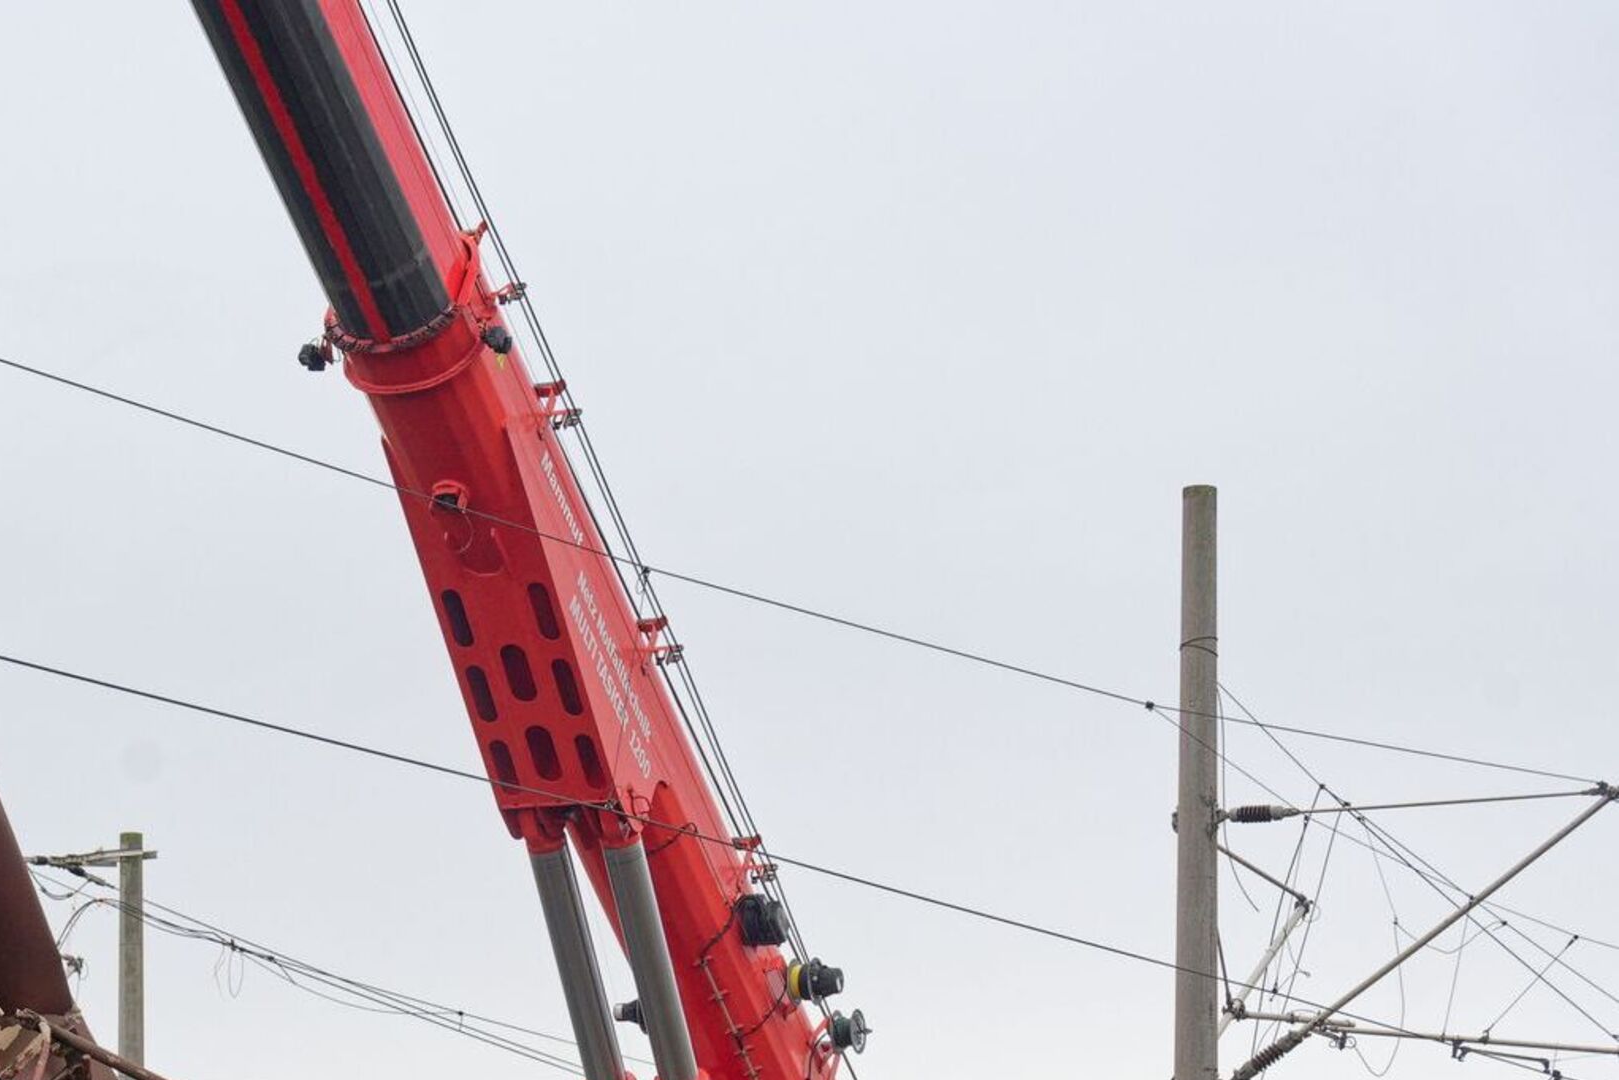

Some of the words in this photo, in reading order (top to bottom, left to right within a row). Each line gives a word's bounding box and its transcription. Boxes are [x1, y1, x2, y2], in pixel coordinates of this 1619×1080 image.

[541, 448, 584, 547] Mammut
[577, 570, 598, 620] Netz
[569, 594, 598, 660] MULTI
[596, 650, 629, 733] TASKER
[629, 729, 651, 779] 1200
